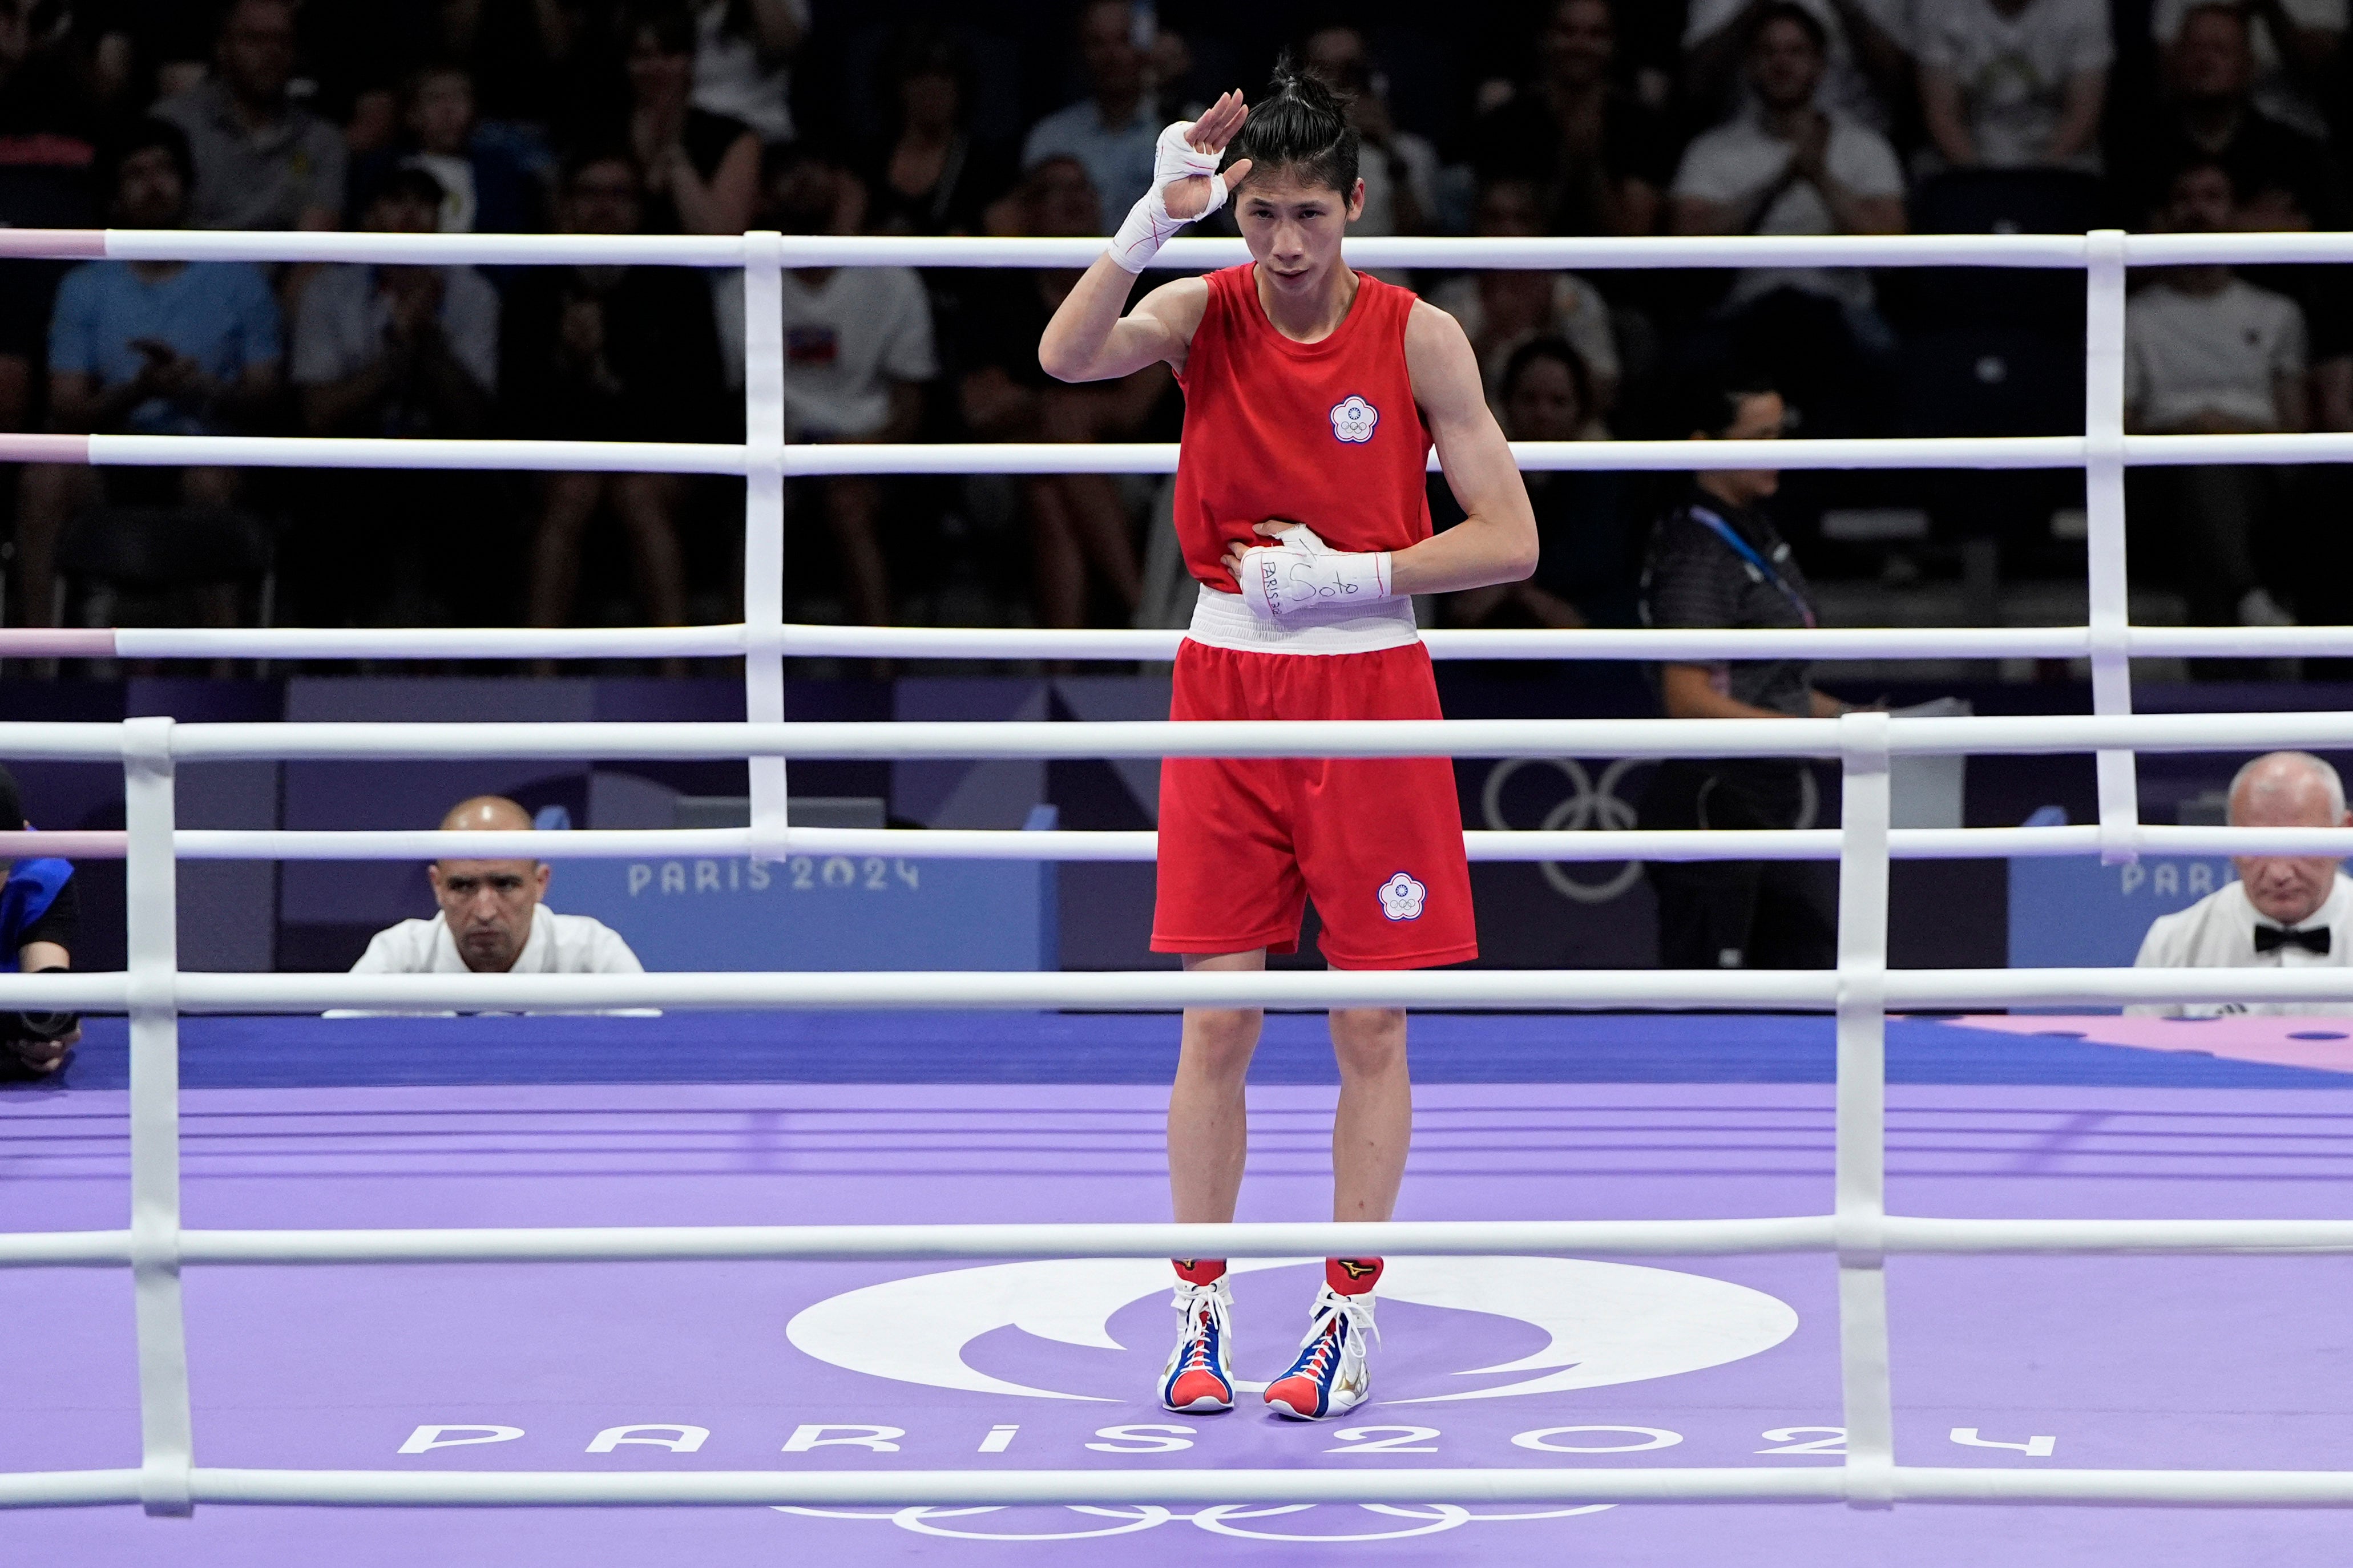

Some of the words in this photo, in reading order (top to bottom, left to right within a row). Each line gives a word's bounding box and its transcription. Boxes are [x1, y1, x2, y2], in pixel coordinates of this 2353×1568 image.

[1262, 561, 1278, 599] PARIS
[629, 859, 770, 896] PARIS
[791, 857, 920, 890] 2024
[2121, 860, 2234, 896] PARI
[397, 1424, 1197, 1453] PARIS
[1322, 1425, 2056, 1457] 2024
